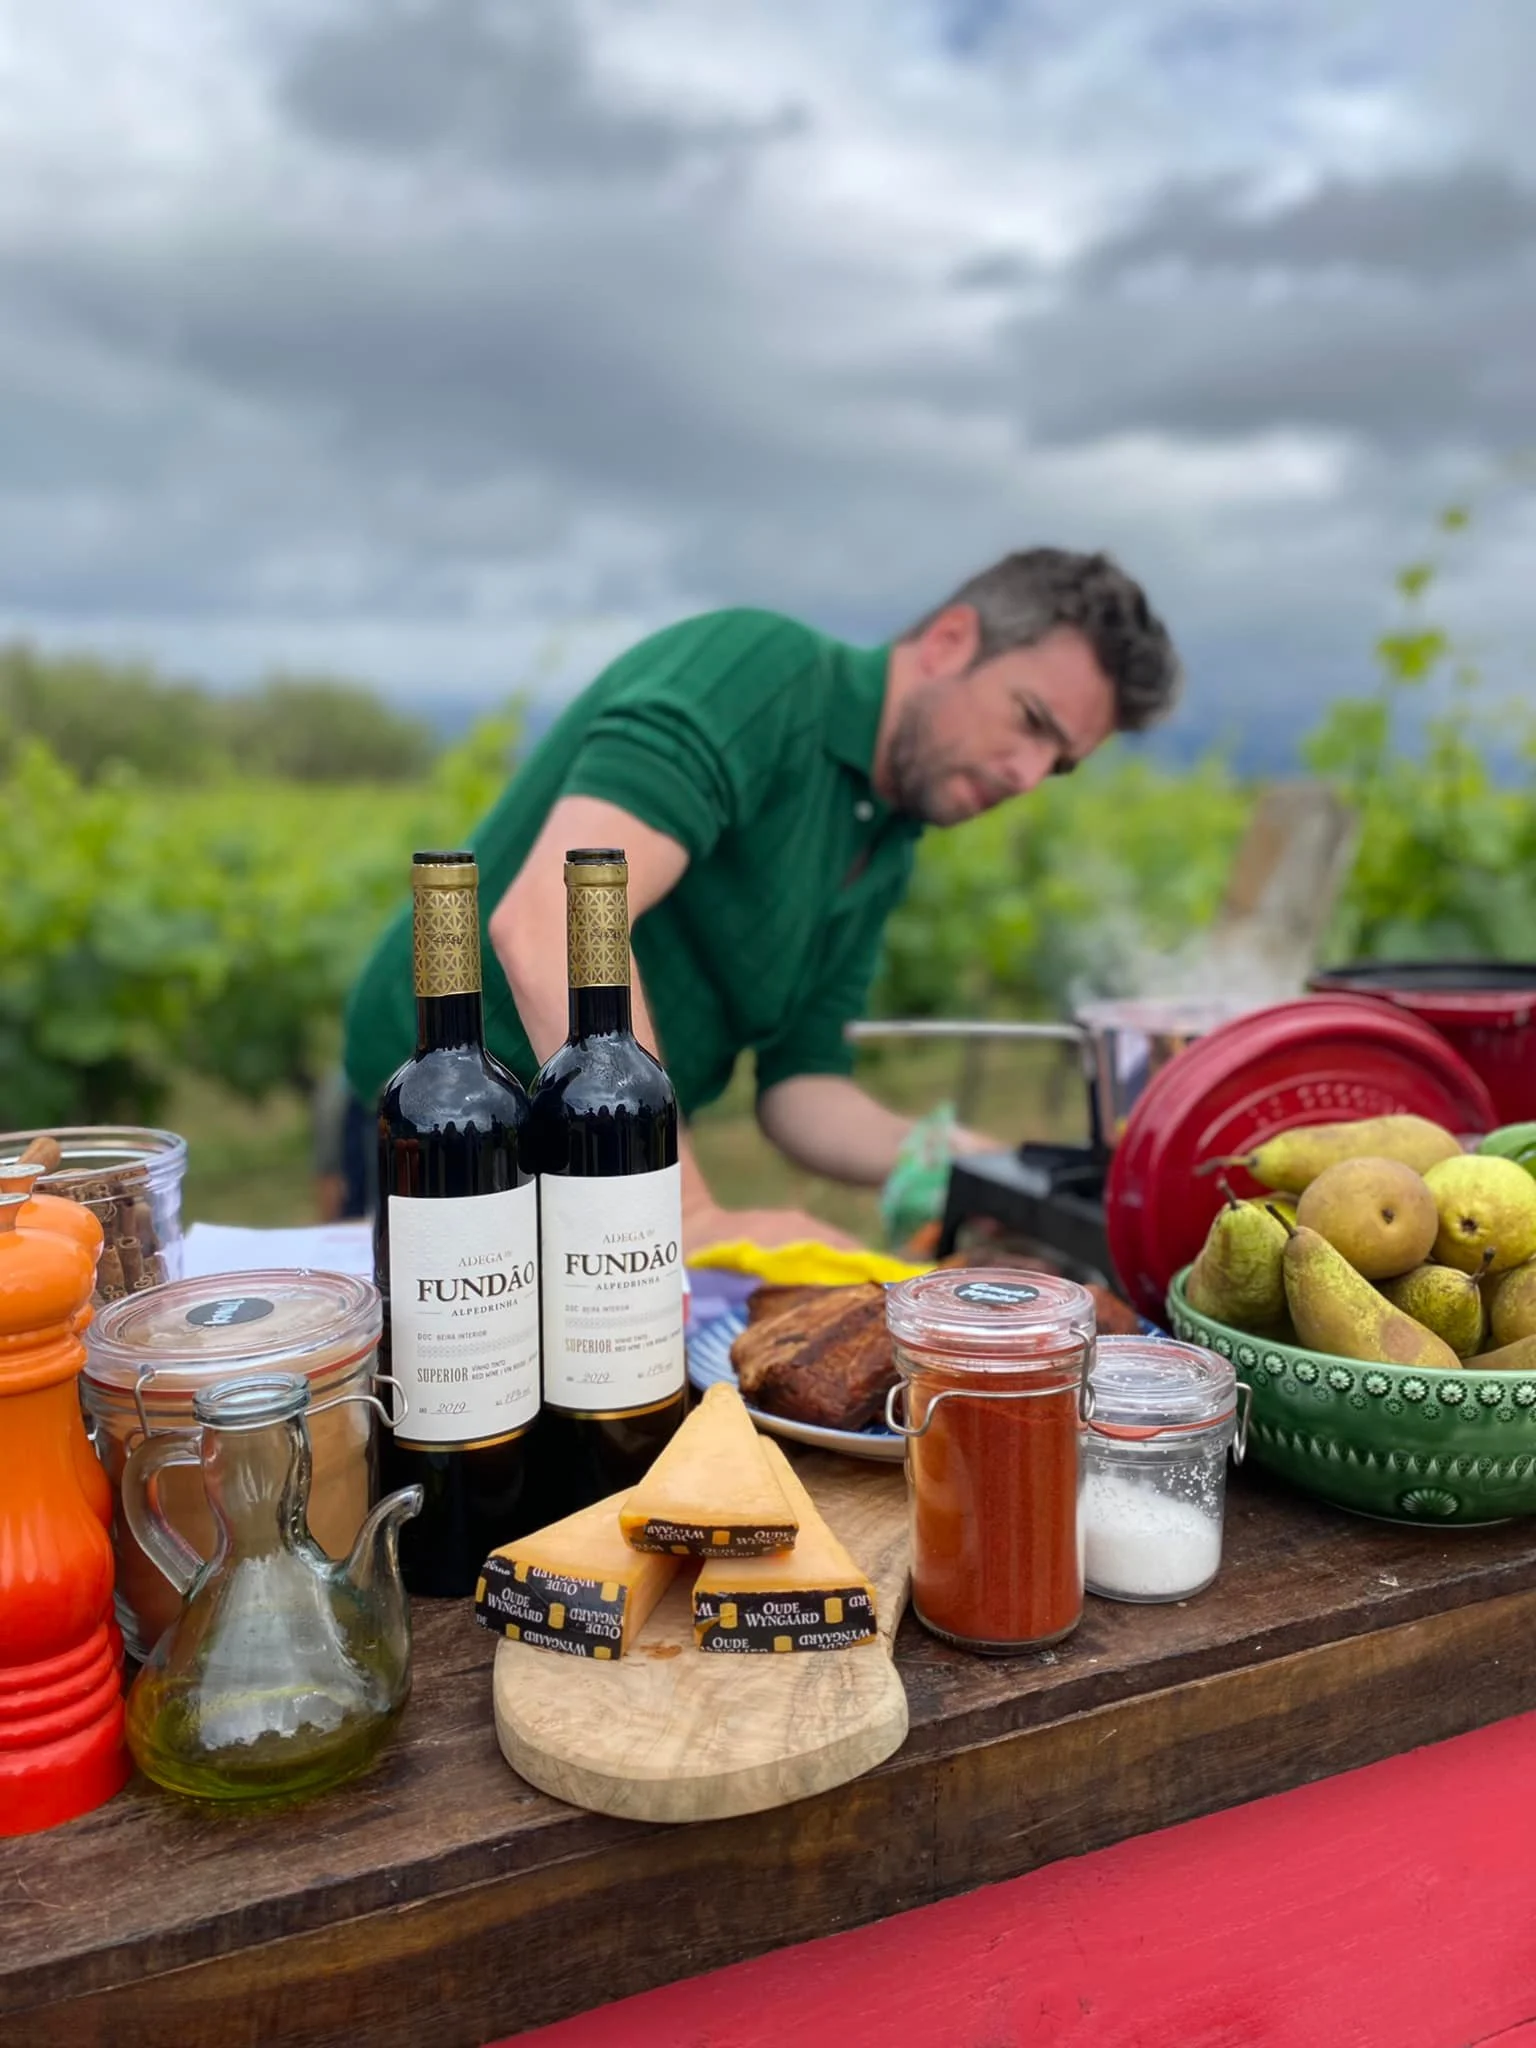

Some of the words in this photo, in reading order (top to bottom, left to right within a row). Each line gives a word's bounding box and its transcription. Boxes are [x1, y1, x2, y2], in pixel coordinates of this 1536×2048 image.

[603, 1231, 645, 1244] ADEGA
[458, 1252, 503, 1267] ADEGA
[564, 1241, 677, 1276] FUNDÃO
[416, 1261, 534, 1302] FUNDÃO
[596, 1276, 660, 1290] ALPEDRINHA
[451, 1299, 518, 1317] ALPEDRINHA
[565, 1338, 612, 1353] SUPERIOR
[417, 1367, 468, 1383] SUPERIOR
[437, 1401, 466, 1414] 2019
[545, 1579, 578, 1596] OUDE
[501, 1587, 531, 1608] OUDE
[487, 1592, 543, 1623] WYNGAARD
[762, 1601, 800, 1615] OUDE
[569, 1607, 624, 1627] YNGAARD
[745, 1612, 820, 1628] WYNGAARD
[585, 1622, 621, 1640] OUDE
[799, 1628, 871, 1646] WYNGAARD
[523, 1630, 587, 1657] WYNGAARD
[712, 1636, 750, 1649] OUDE
